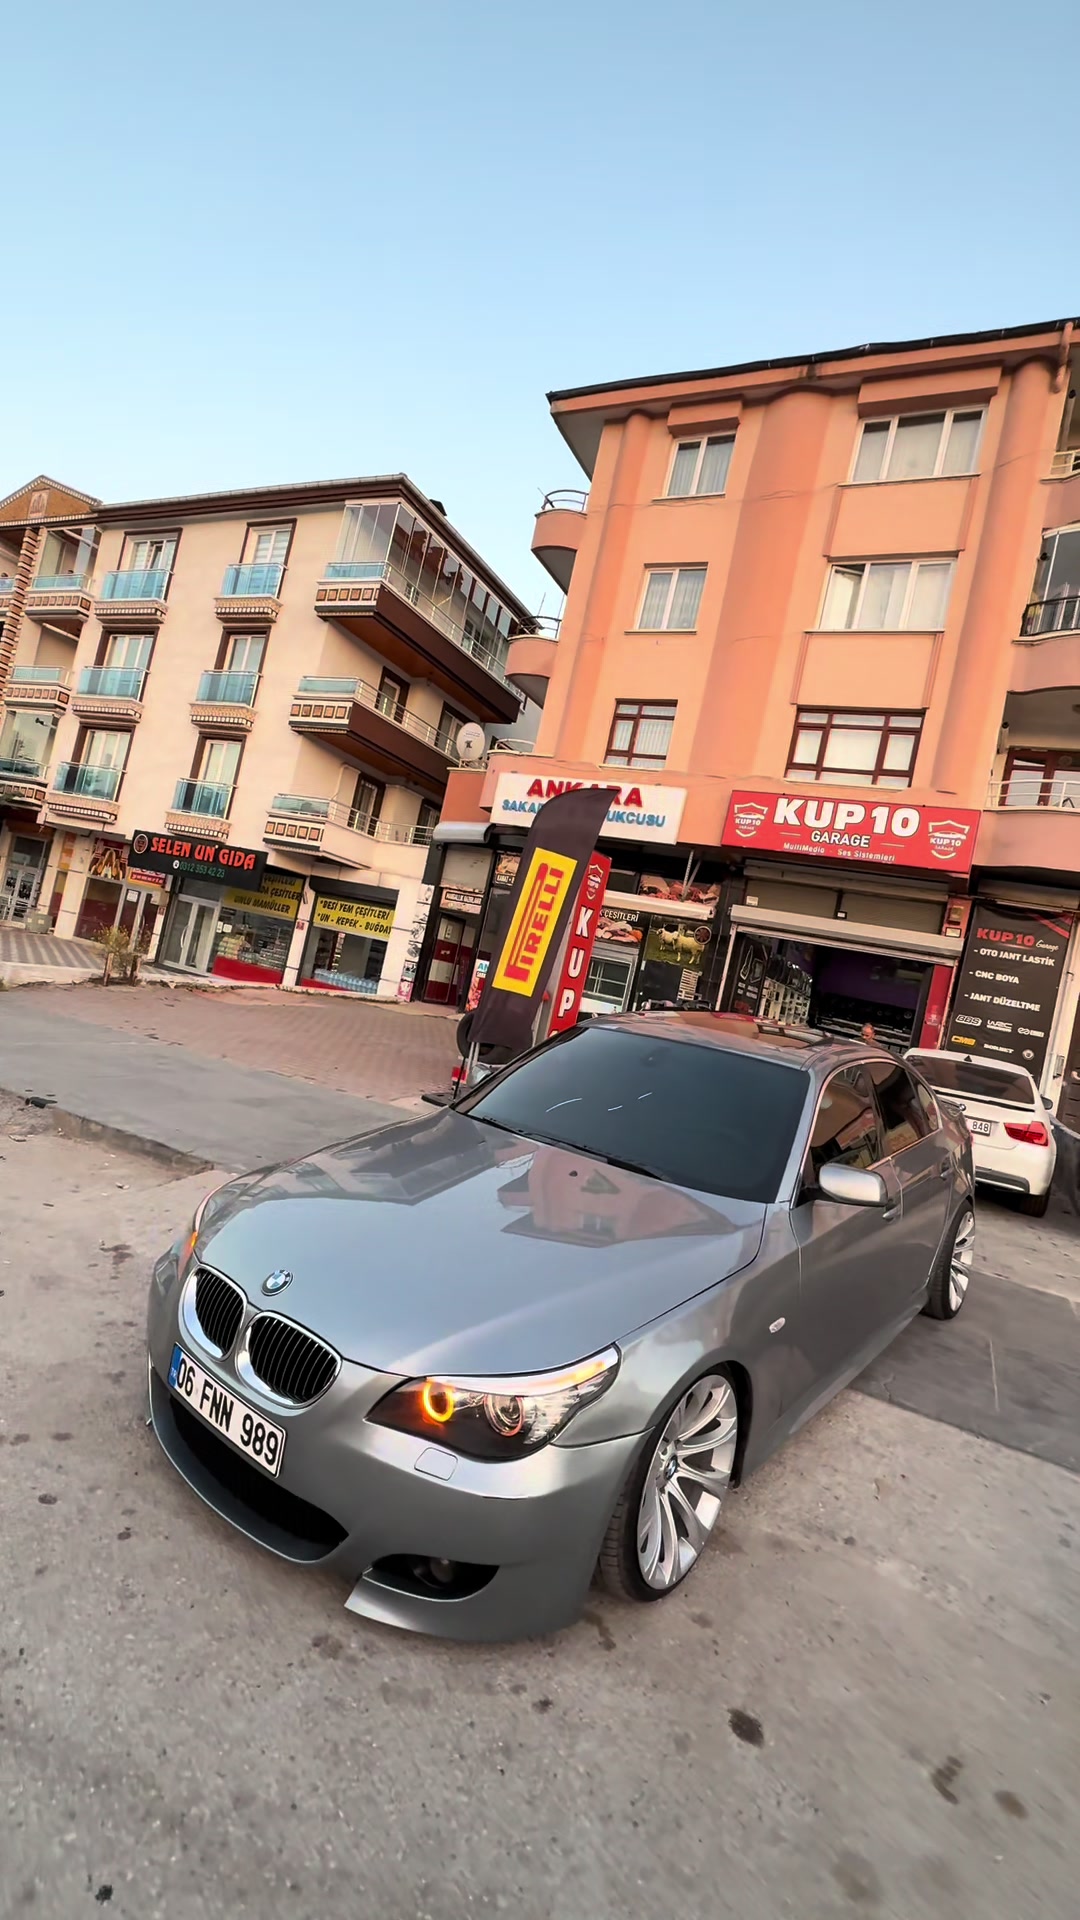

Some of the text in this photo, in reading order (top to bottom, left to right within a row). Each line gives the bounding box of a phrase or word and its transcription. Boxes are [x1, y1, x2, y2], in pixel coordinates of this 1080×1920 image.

[606, 809, 666, 828] UKCUSU
[772, 797, 921, 838] KUP 10
[810, 830, 871, 849] GARAGE
[150, 836, 192, 858] SELEN
[218, 849, 257, 870] GIDA
[853, 850, 896, 862] Sistemleri
[339, 903, 354, 914] YEM
[355, 906, 390, 921] ÇEŞİTLERİ
[336, 916, 359, 928] KEPEK
[504, 862, 565, 984] PIRELLI
[976, 927, 1059, 953] KUP 10 Garage
[979, 948, 1055, 967] OTO JANT LASTİK
[975, 970, 1020, 984] CNC BOYA
[970, 992, 1041, 1012] JANT DÜZELTME
[972, 1120, 990, 1132] 848
[176, 1357, 279, 1467] 06 FNN 989
